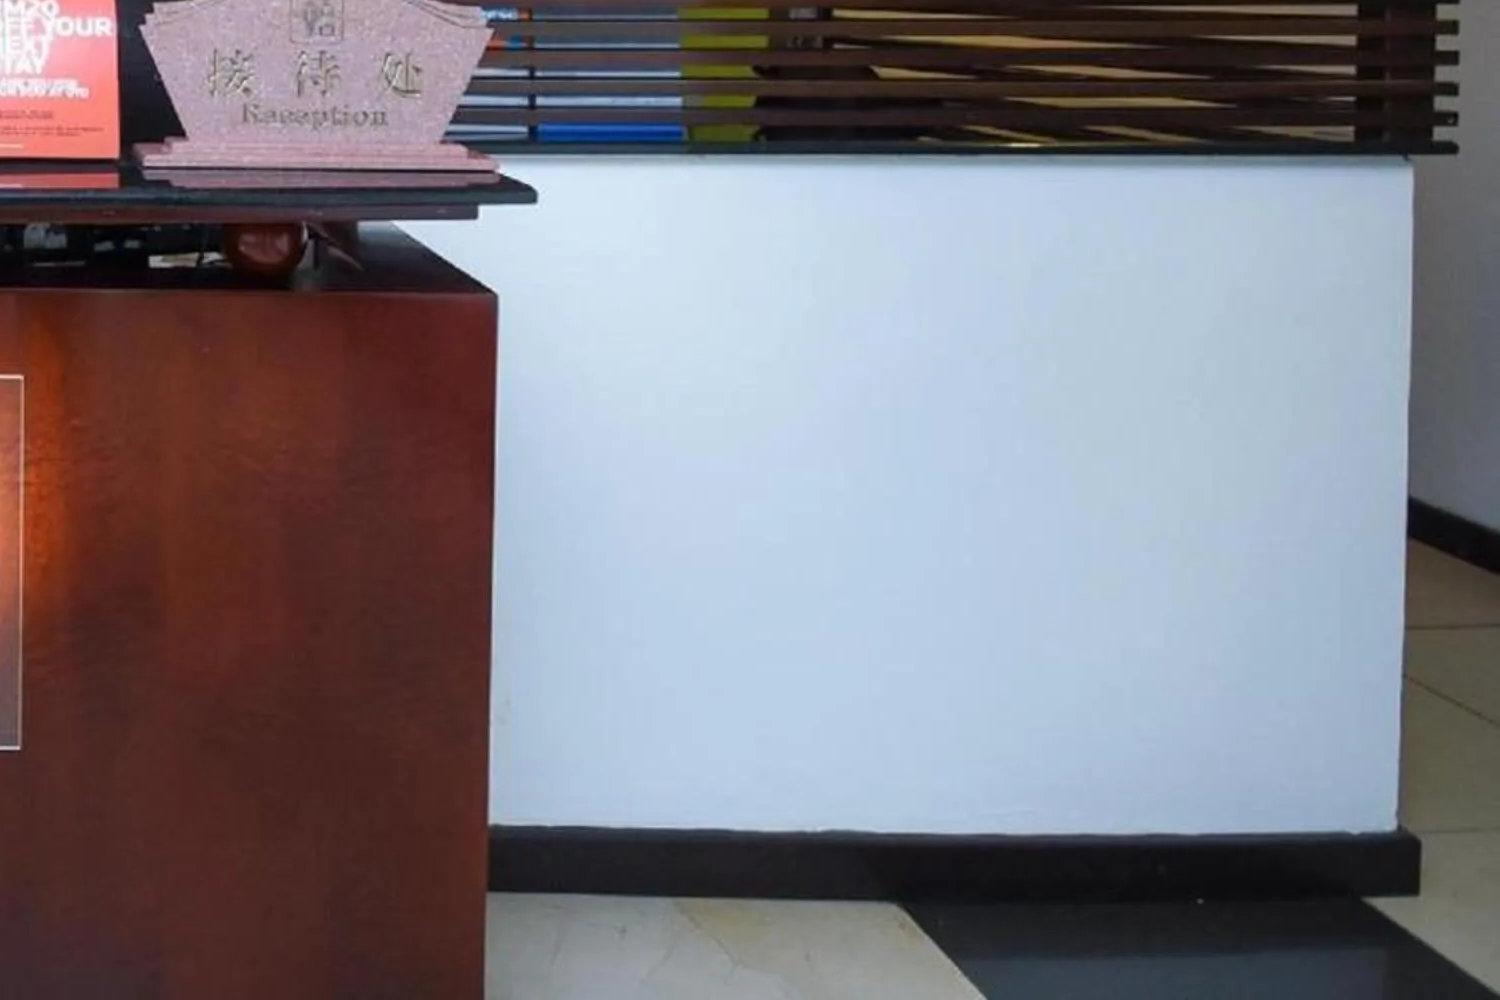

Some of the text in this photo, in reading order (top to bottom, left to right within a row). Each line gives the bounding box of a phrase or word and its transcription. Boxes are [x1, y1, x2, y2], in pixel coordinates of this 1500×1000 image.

[34, 15, 114, 37] YOUR
[207, 49, 426, 98] 接待处
